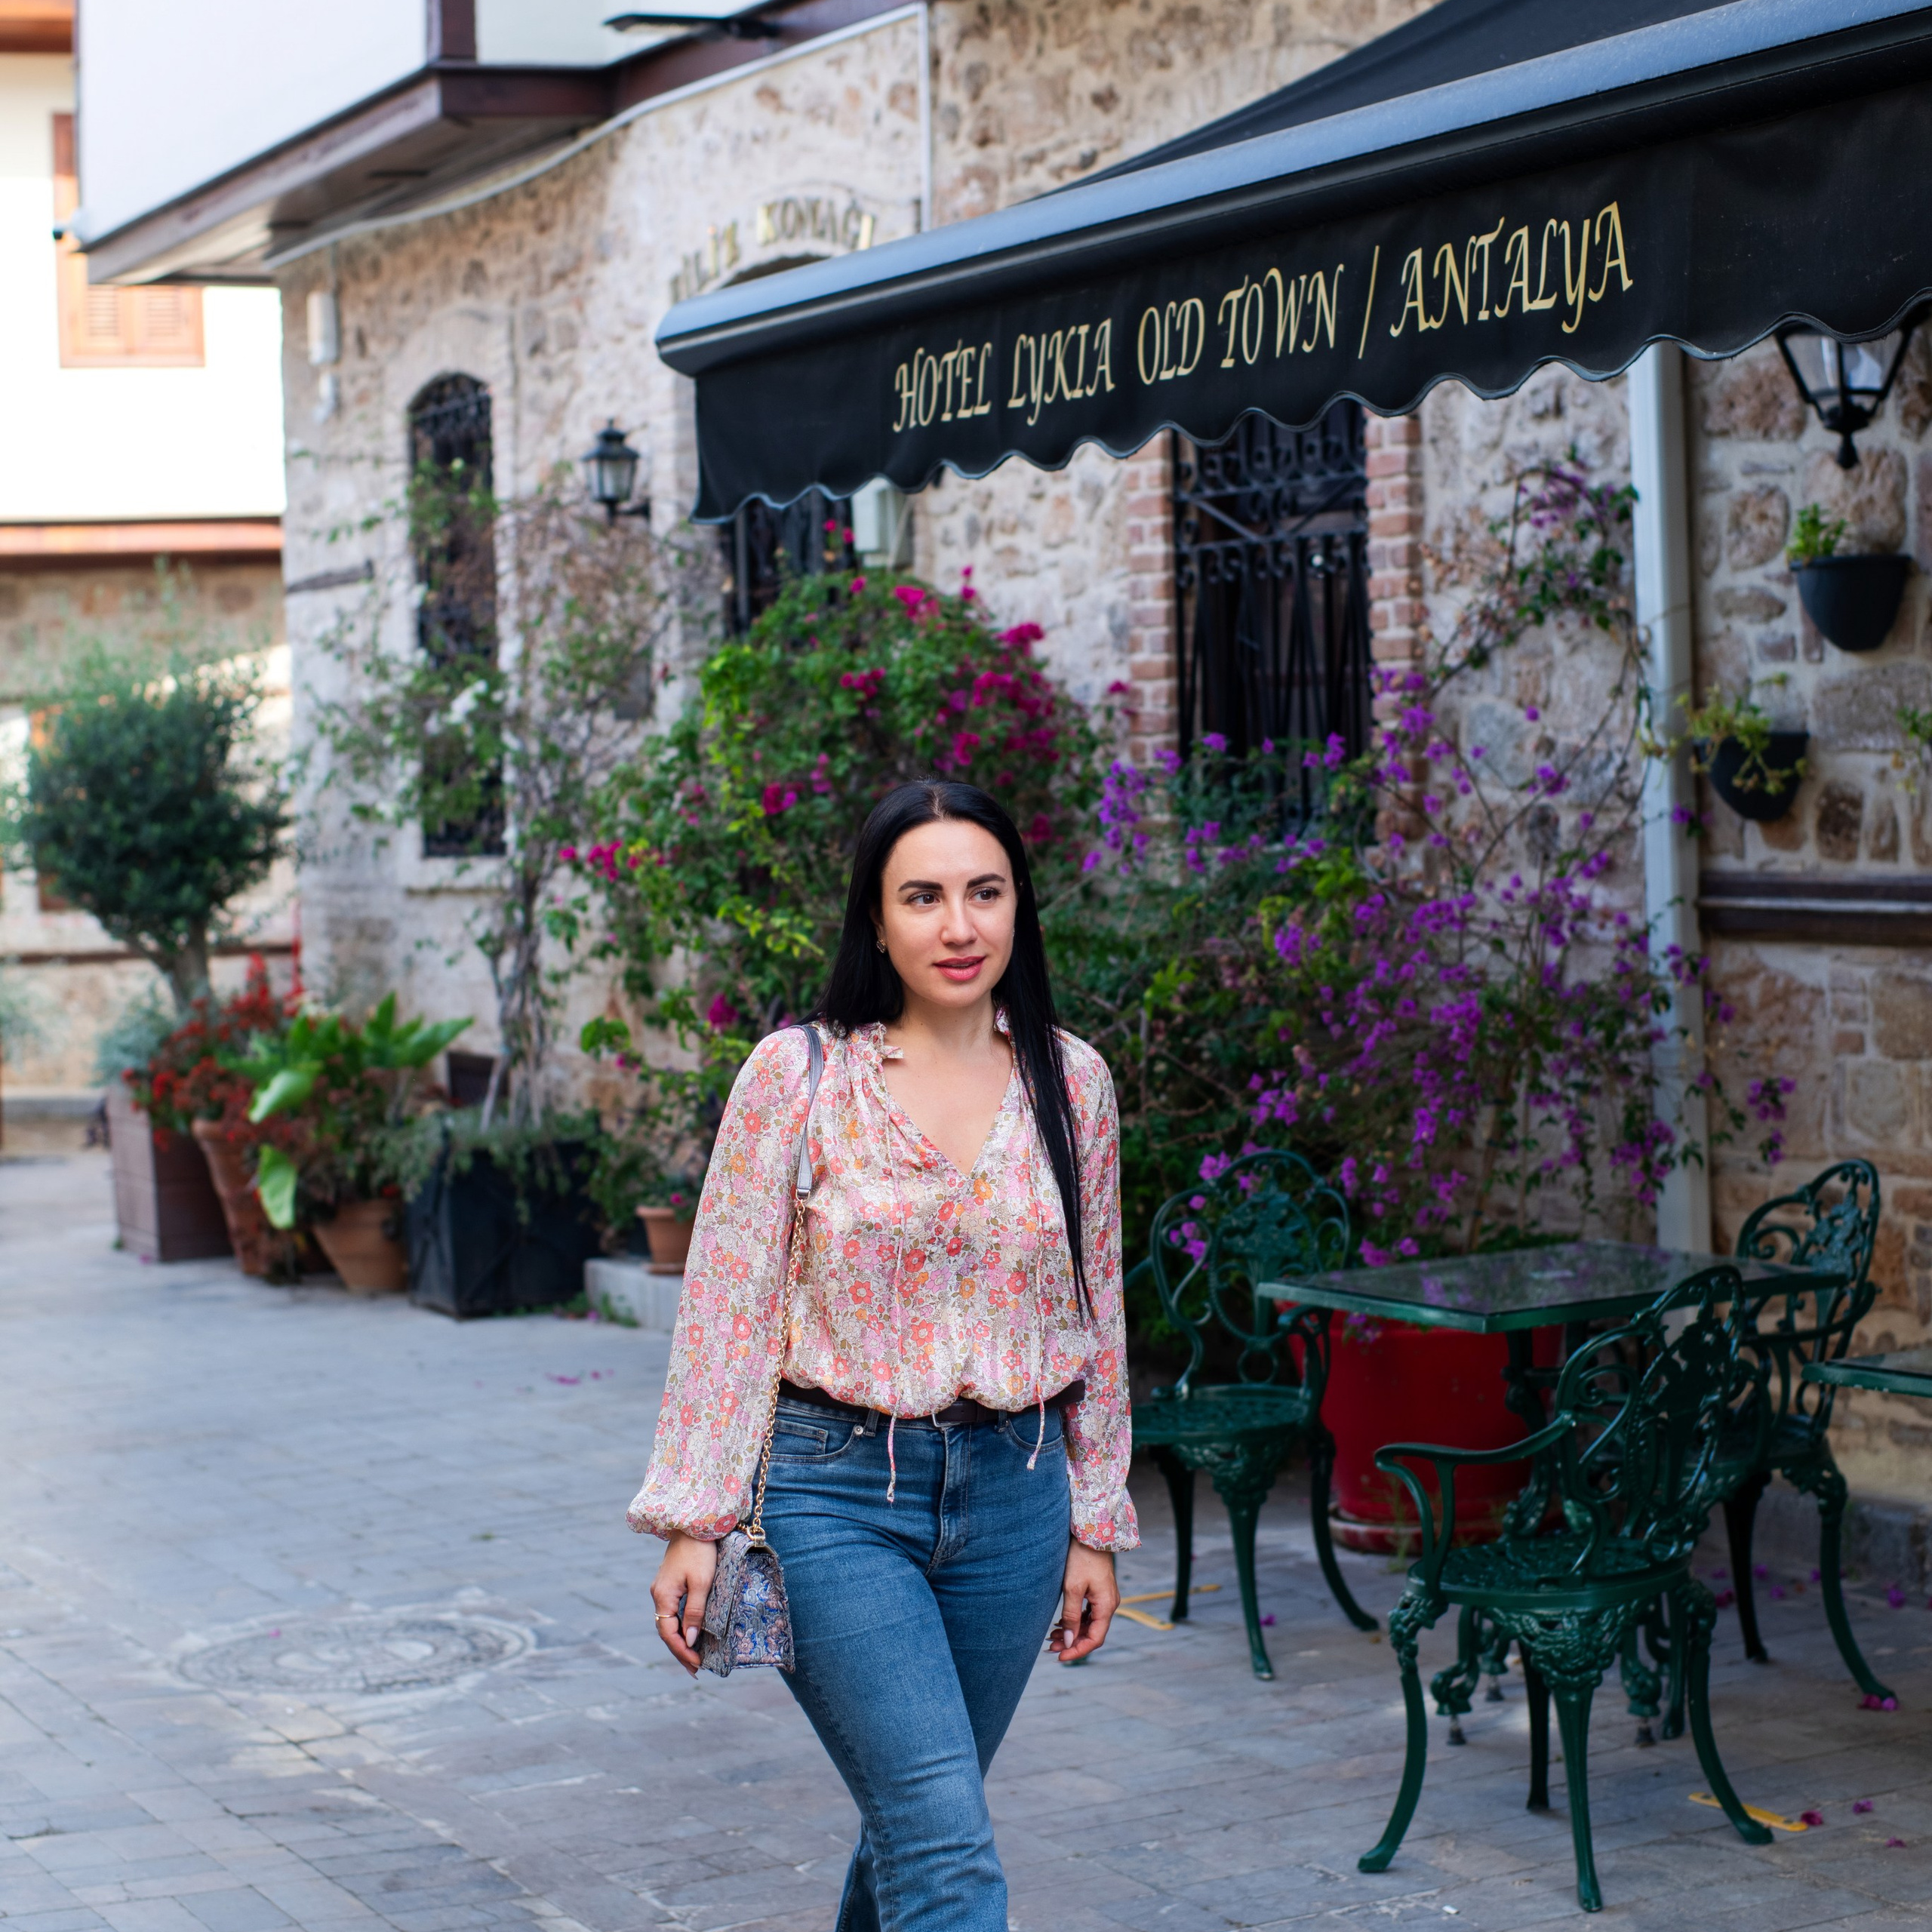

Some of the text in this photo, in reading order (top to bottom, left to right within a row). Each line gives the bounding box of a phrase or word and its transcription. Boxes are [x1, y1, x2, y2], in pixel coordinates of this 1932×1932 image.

[893, 339, 992, 432] HOTEL
[1008, 318, 1115, 426] LYKIA
[1137, 297, 1205, 384] OLD
[1217, 264, 1344, 368] TOWN
[1389, 200, 1633, 337] ANTALYA
